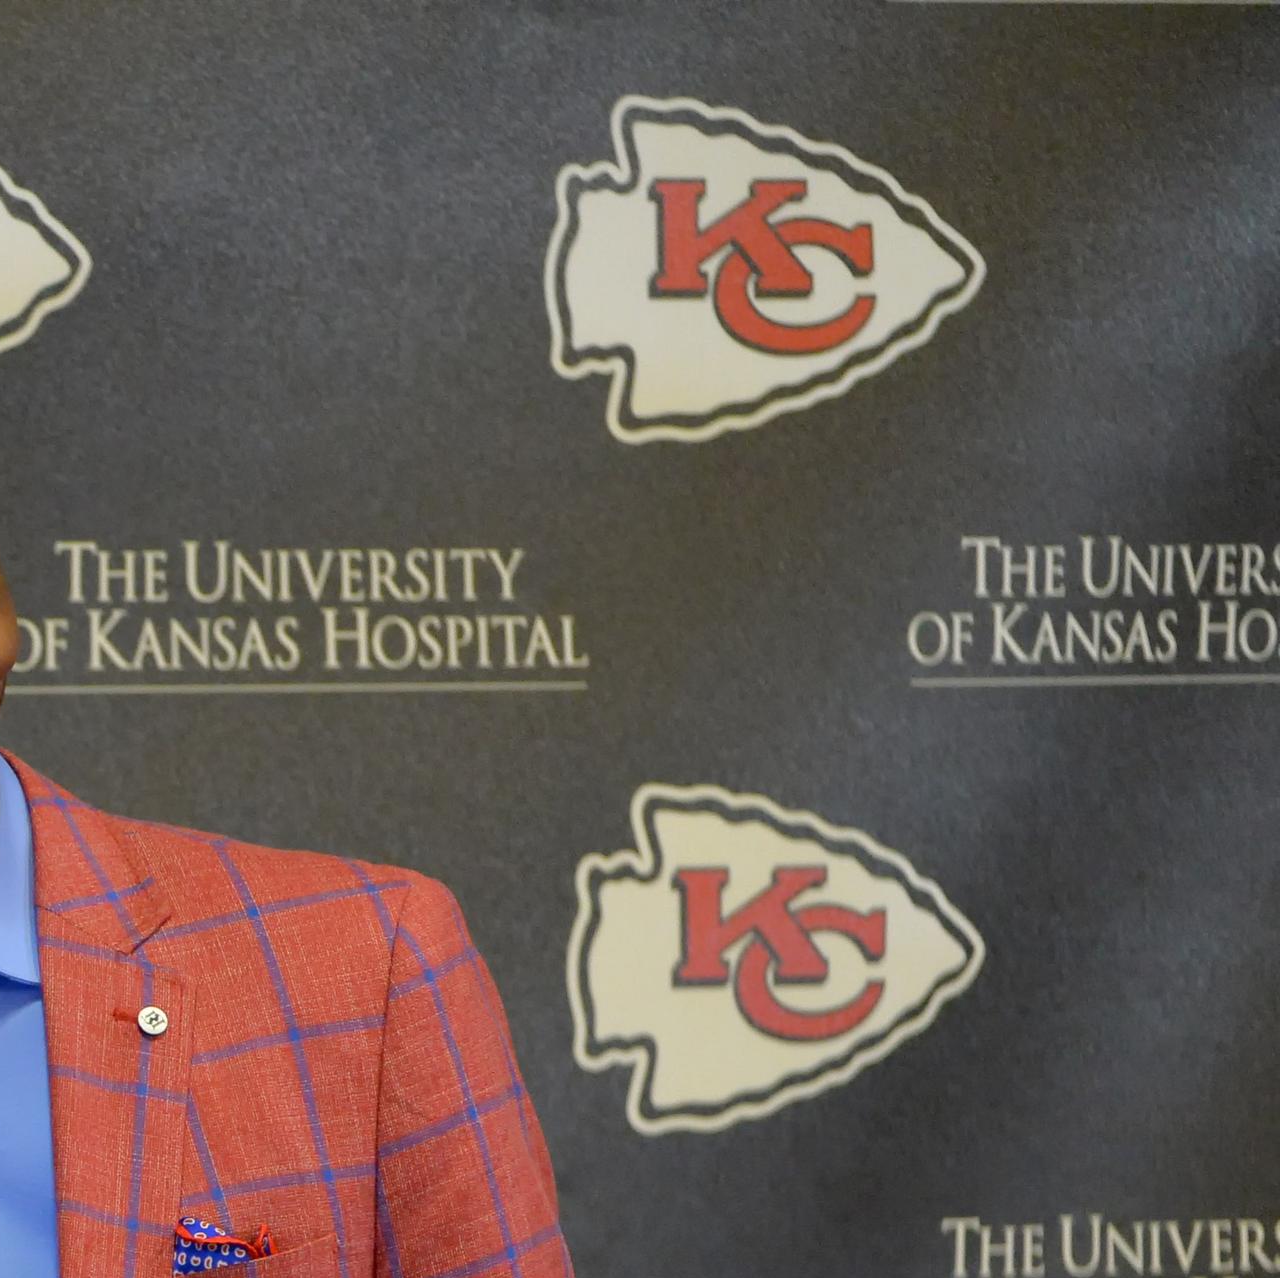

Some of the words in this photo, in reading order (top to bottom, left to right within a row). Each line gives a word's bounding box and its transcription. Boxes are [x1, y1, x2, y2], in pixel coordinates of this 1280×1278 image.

[649, 178, 876, 356] KC
[53, 540, 169, 603] THE
[182, 539, 525, 604] UNIVERSITY
[961, 536, 1066, 598] THE
[87, 607, 302, 672] KANSAS
[321, 606, 590, 671] HOSPITAL
[992, 601, 1178, 666] KANSAS
[672, 864, 887, 1042] KC
